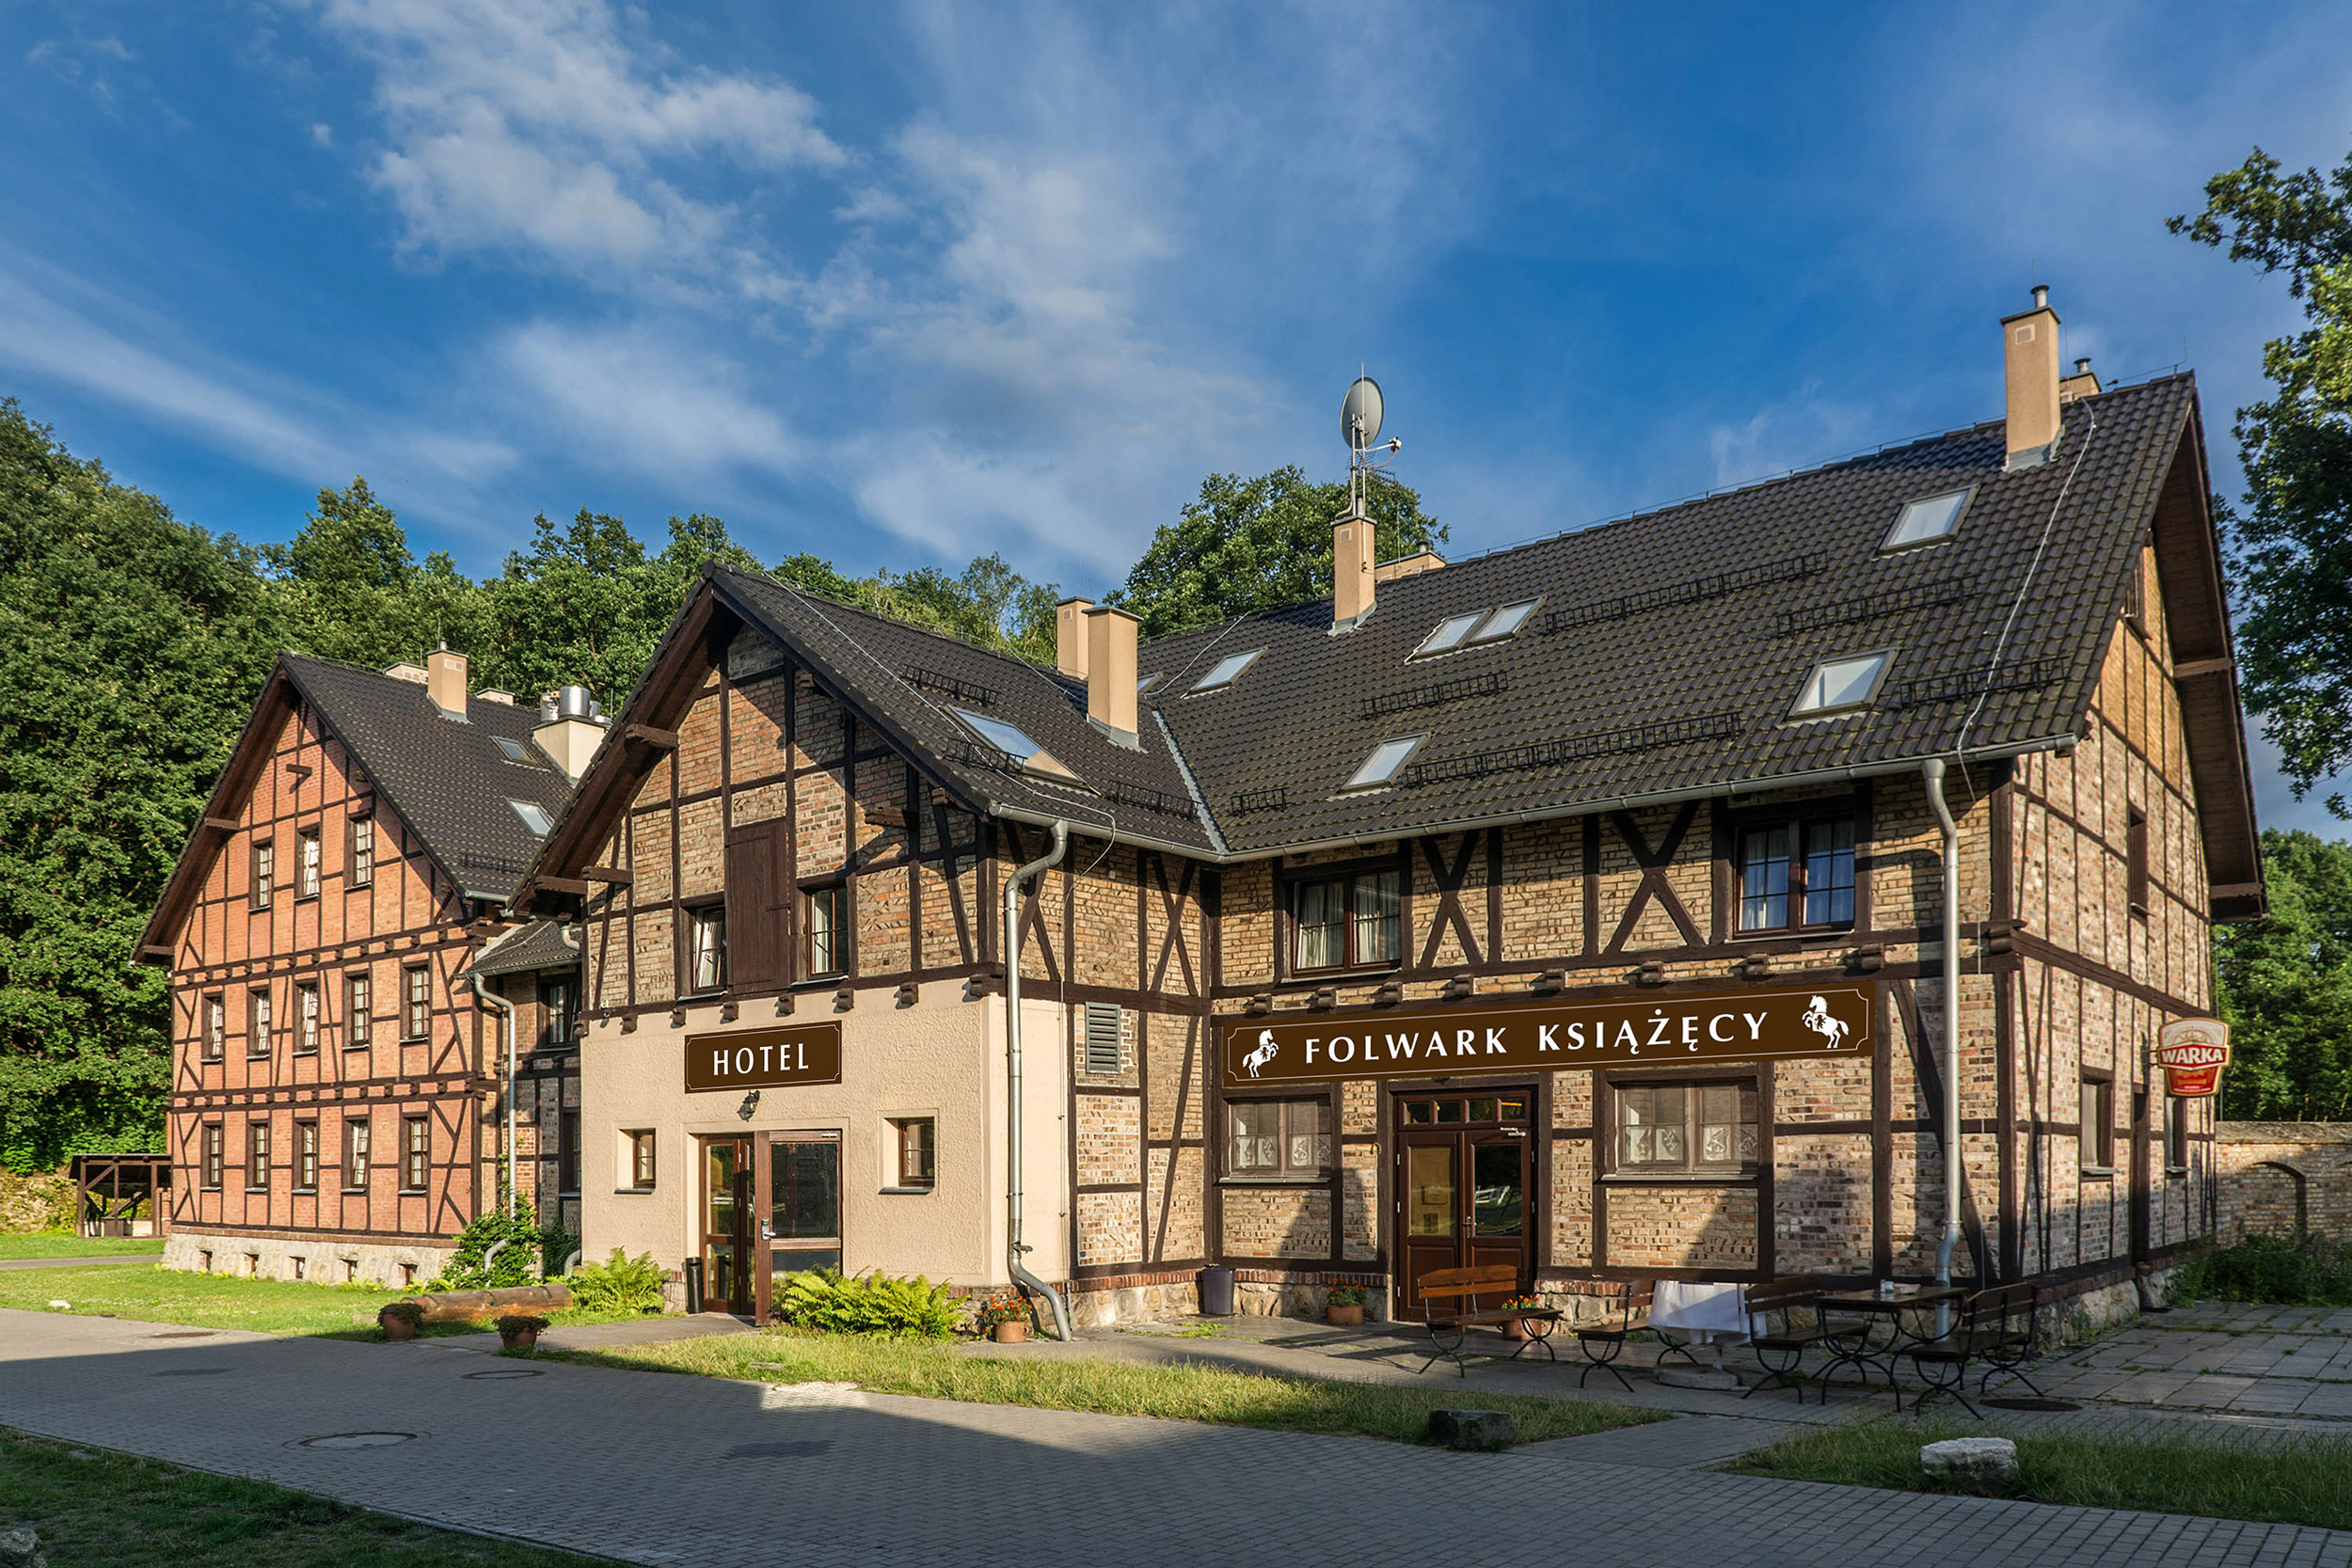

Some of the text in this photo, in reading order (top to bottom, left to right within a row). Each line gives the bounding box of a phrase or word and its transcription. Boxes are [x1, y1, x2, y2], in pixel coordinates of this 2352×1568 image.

[1306, 1009, 1768, 1063] FOLWARK KSIĄŻĘCY
[713, 1042, 809, 1076] HOTEL
[2162, 1048, 2223, 1064] WARKA
